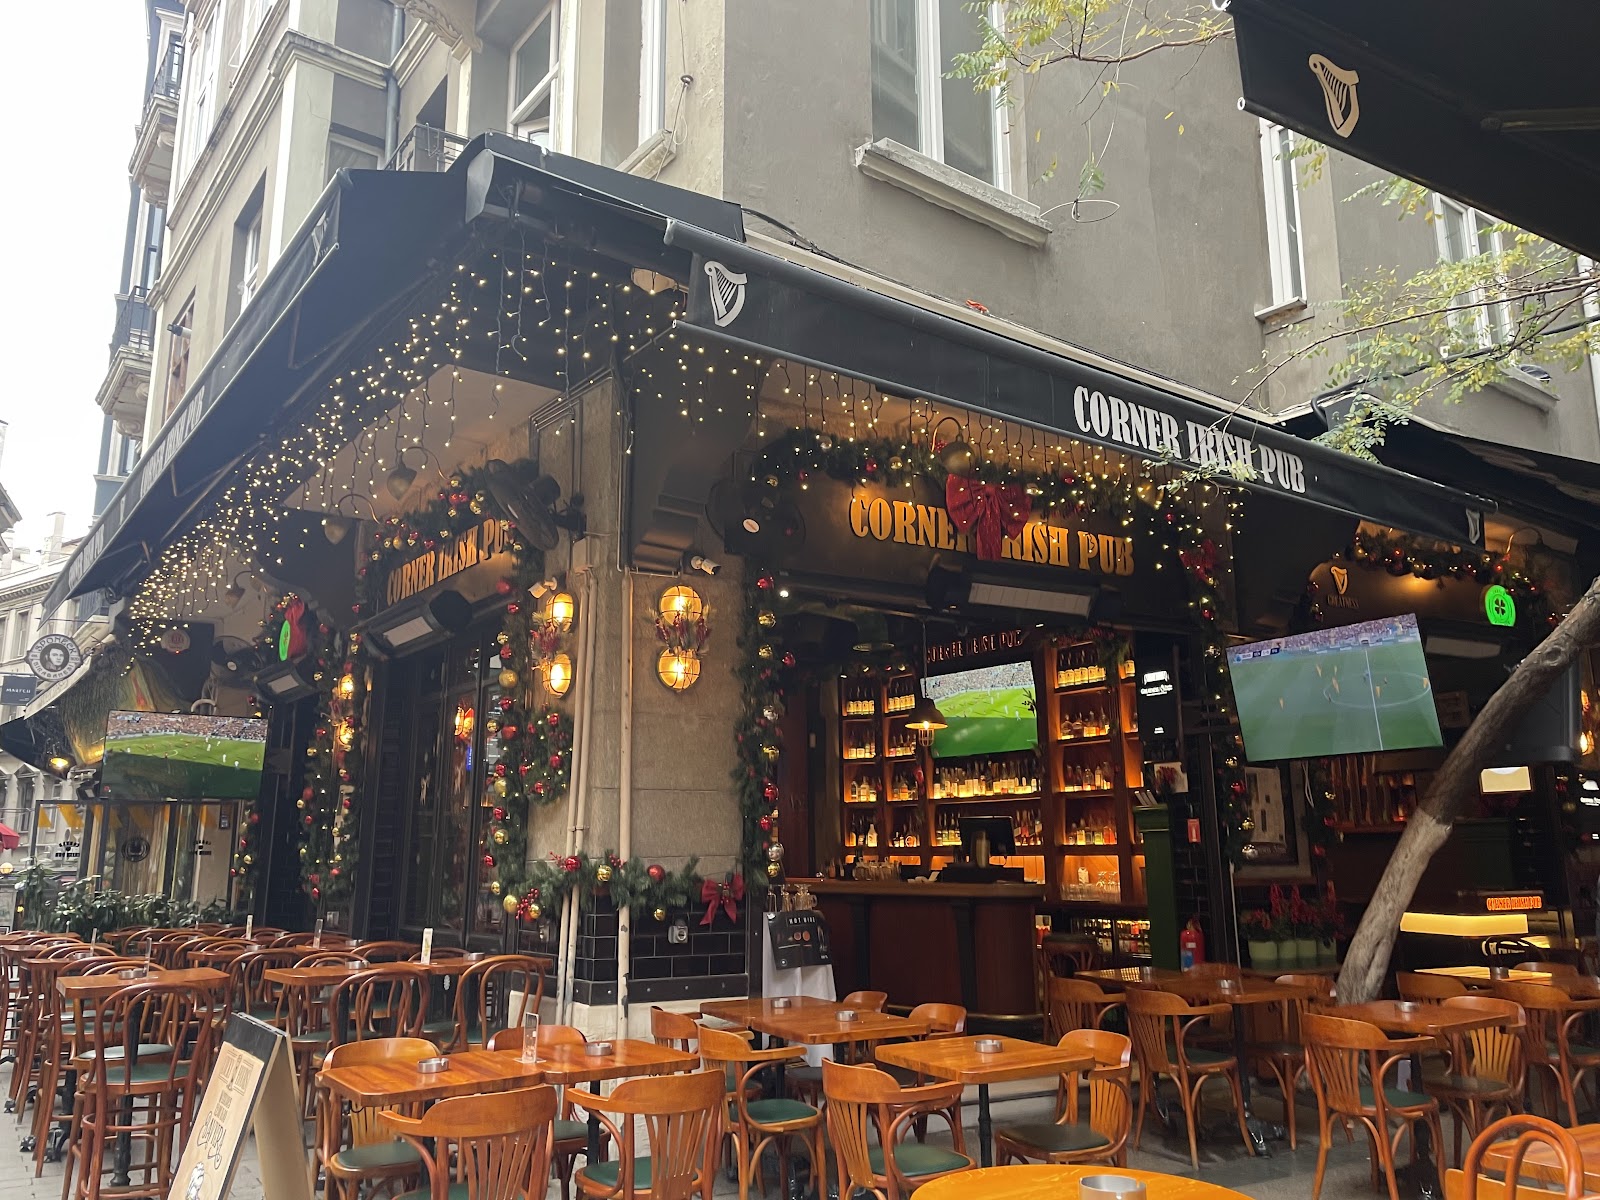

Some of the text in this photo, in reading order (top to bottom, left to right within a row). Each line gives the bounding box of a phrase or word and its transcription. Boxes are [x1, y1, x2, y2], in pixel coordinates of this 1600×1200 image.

[1073, 385, 1307, 495] CORNER IRISH PUB
[386, 518, 508, 607] CORNER IRISH PU
[1078, 530, 1136, 577] PUB
